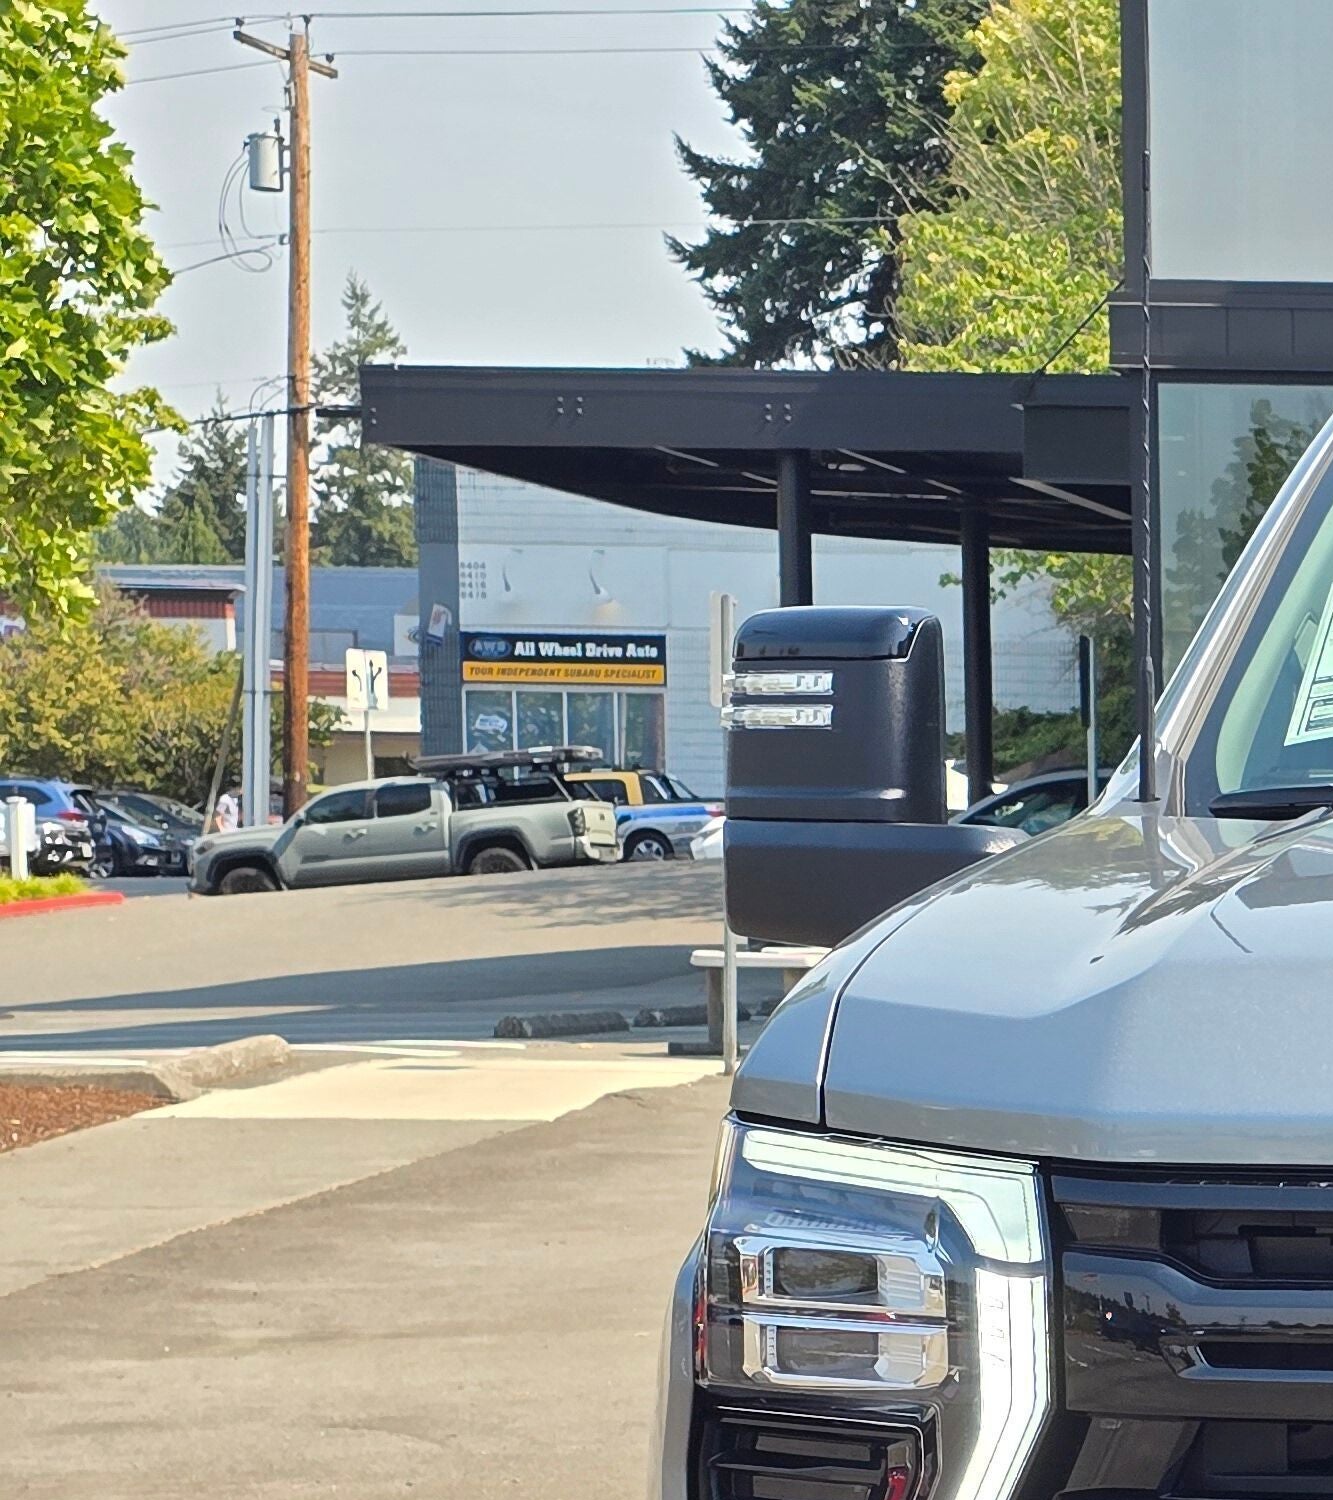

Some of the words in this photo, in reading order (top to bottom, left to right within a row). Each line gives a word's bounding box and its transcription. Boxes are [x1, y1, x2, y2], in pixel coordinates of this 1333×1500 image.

[514, 641, 536, 657] All
[538, 641, 583, 658] Wheel
[585, 642, 623, 658] Drive
[626, 642, 658, 659] Auto
[469, 666, 494, 677] YOUR
[496, 666, 563, 679] INDEPENDENT
[564, 667, 602, 679] SUBARU
[603, 668, 657, 680] SPECIALIST
